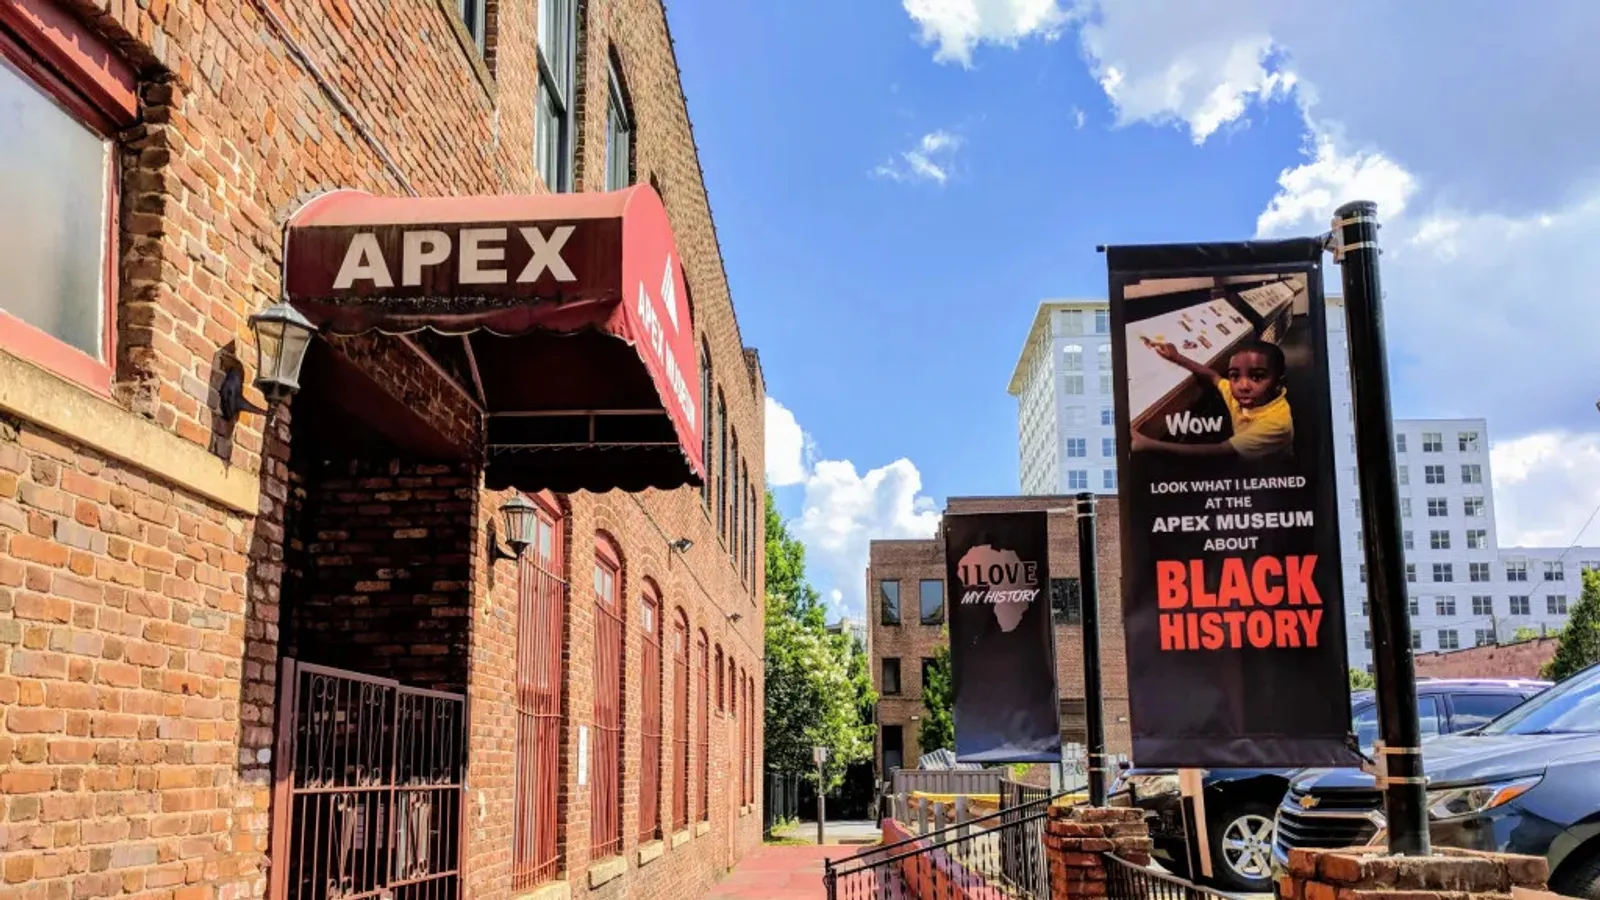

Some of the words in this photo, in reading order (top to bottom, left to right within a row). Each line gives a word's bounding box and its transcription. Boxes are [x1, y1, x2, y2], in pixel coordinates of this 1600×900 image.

[332, 225, 577, 289] APEX
[638, 280, 664, 365] APEX
[1165, 411, 1223, 436] Wow
[1151, 482, 1188, 493] LOOK
[1191, 480, 1232, 491] WHAT
[1235, 479, 1240, 489] I
[1243, 476, 1306, 490] LEARNED
[1205, 498, 1223, 509] AT
[1225, 497, 1252, 507] THE
[1152, 515, 1210, 532] APEX
[1217, 511, 1313, 530] MUSEUM
[1203, 537, 1258, 551] ABOUT
[961, 564, 970, 586] I
[974, 561, 1037, 586] LOVE
[1156, 555, 1322, 609] BLACK
[961, 591, 984, 604] MY
[984, 589, 1040, 604] HISTORY
[1159, 609, 1323, 650] HISTORY
